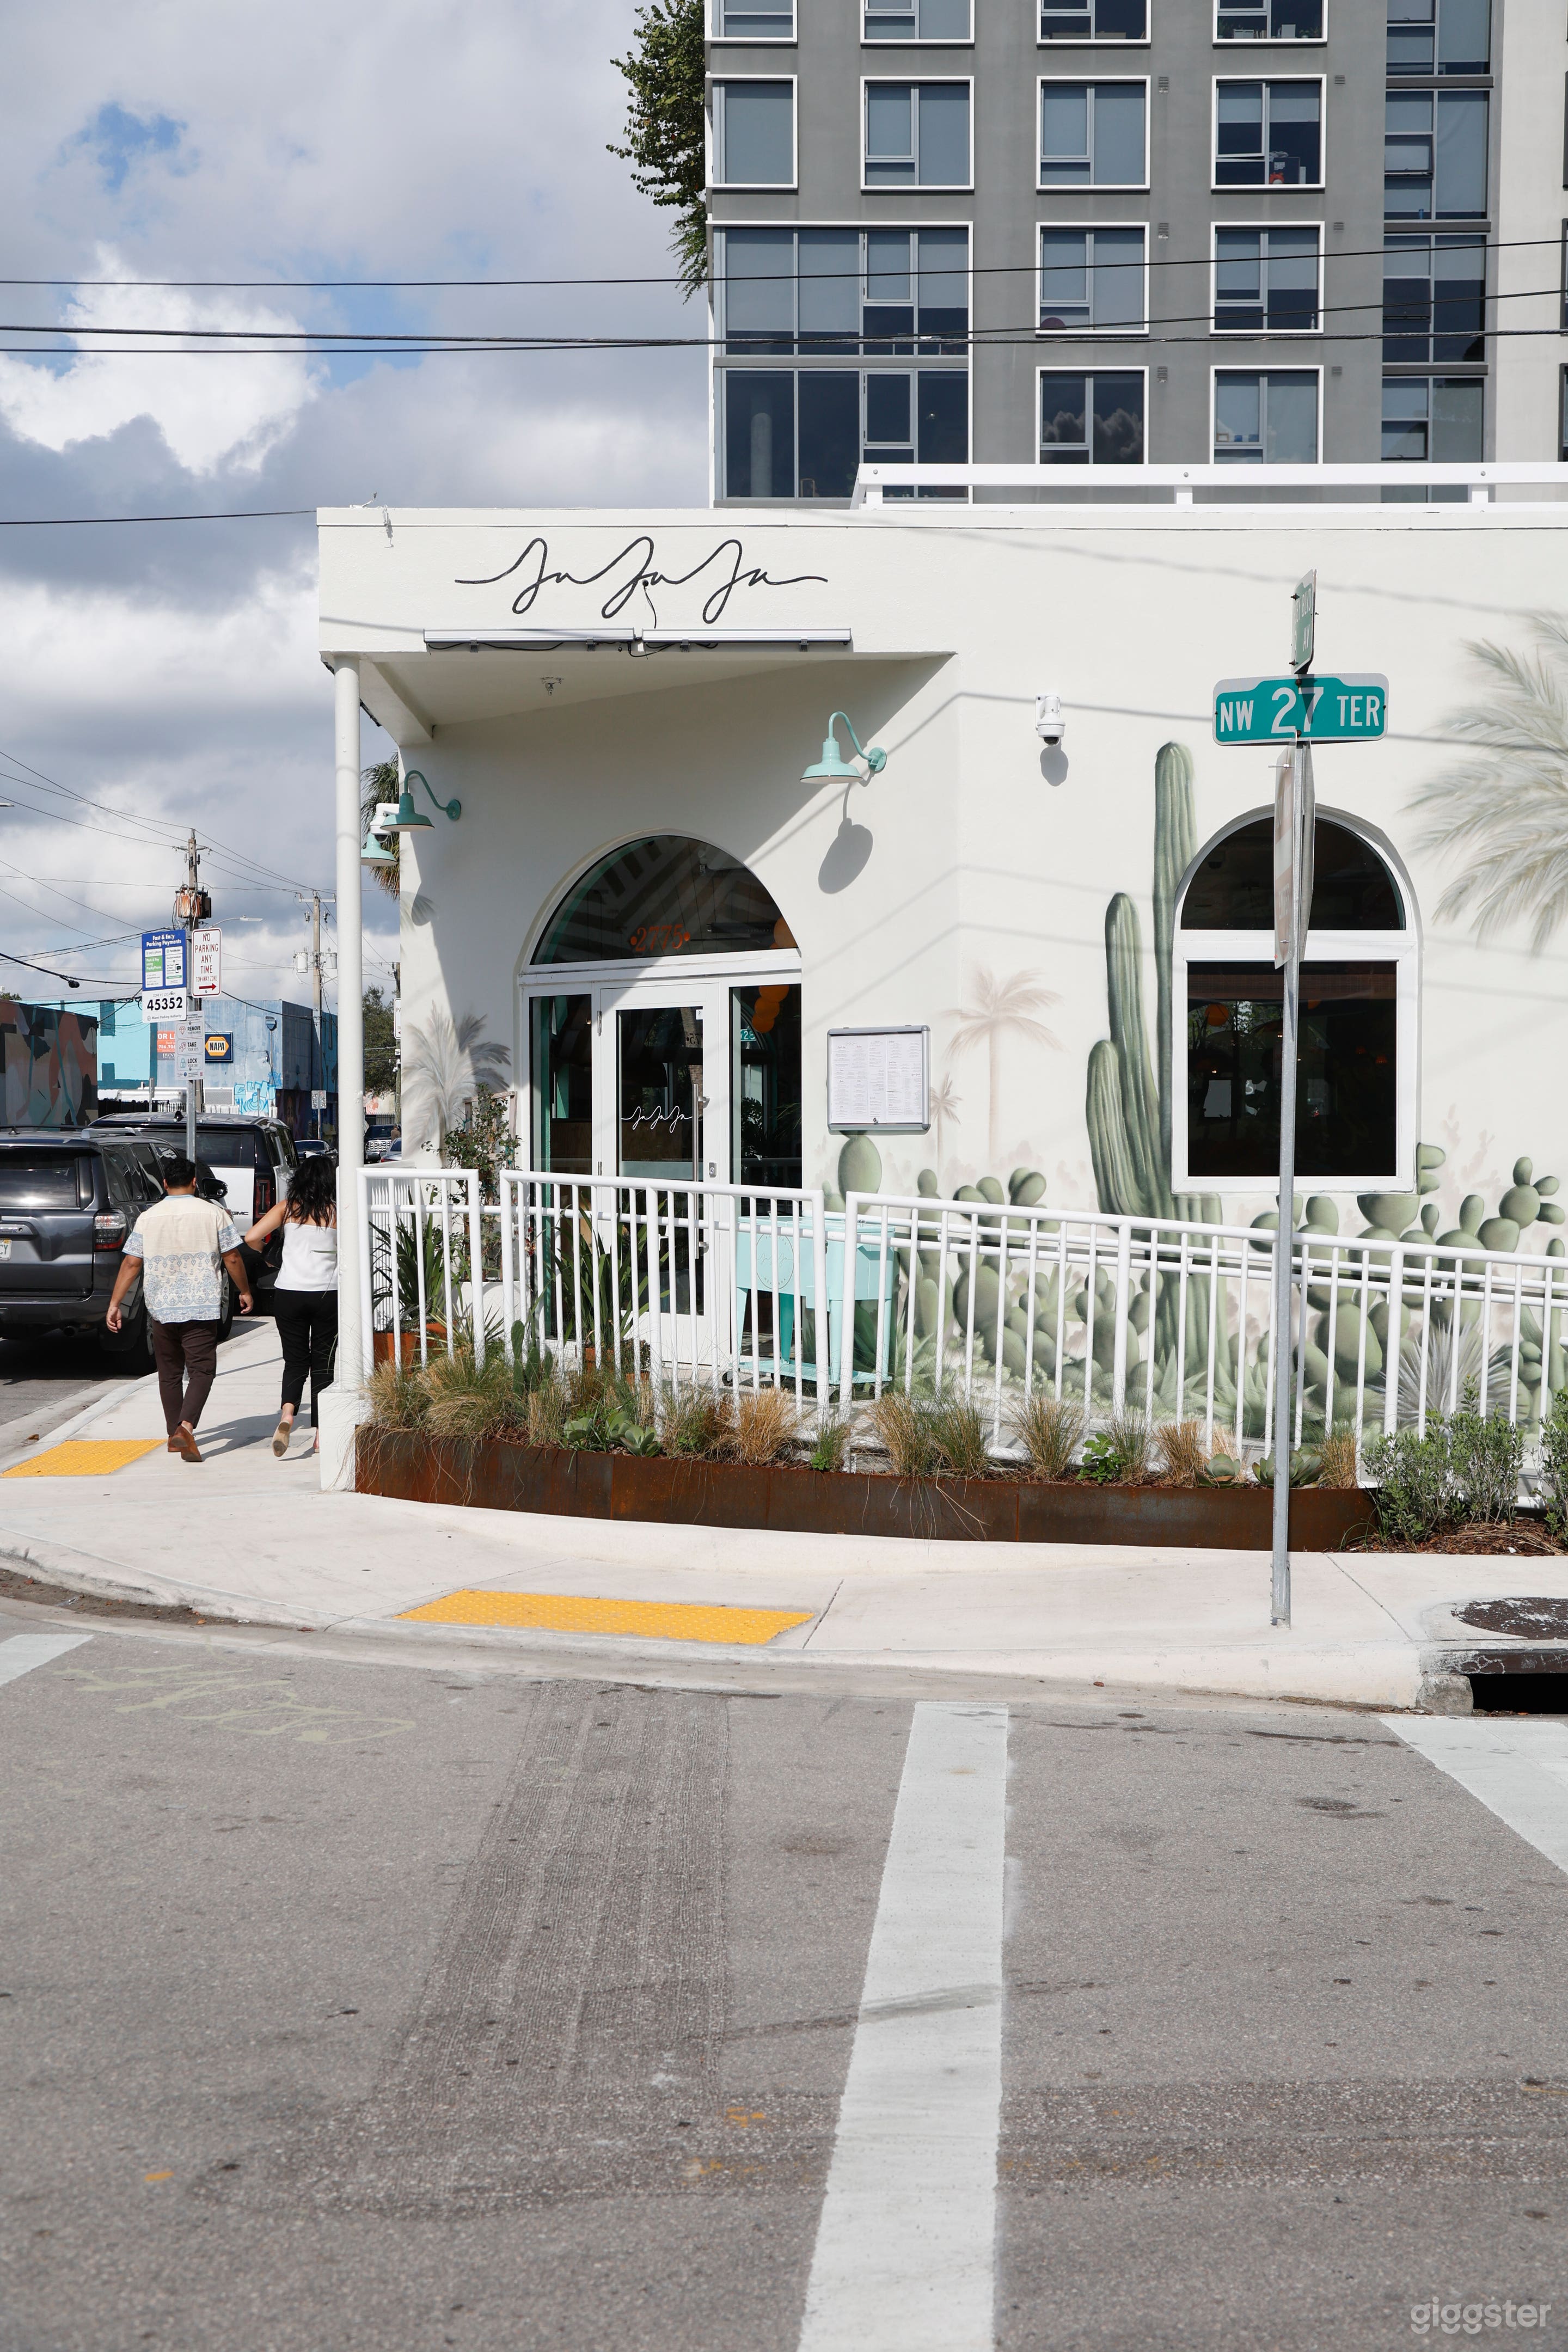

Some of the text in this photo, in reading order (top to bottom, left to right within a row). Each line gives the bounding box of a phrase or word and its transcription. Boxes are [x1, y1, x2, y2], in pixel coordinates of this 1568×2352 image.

[1220, 687, 1380, 734] NW 27 TER
[203, 933, 211, 942] NO
[635, 924, 683, 952] 2775
[195, 943, 218, 953] PARKING
[201, 954, 212, 964] ANY
[200, 965, 213, 974] TIME
[147, 996, 183, 1011] 45352
[209, 1042, 225, 1051] NAPA
